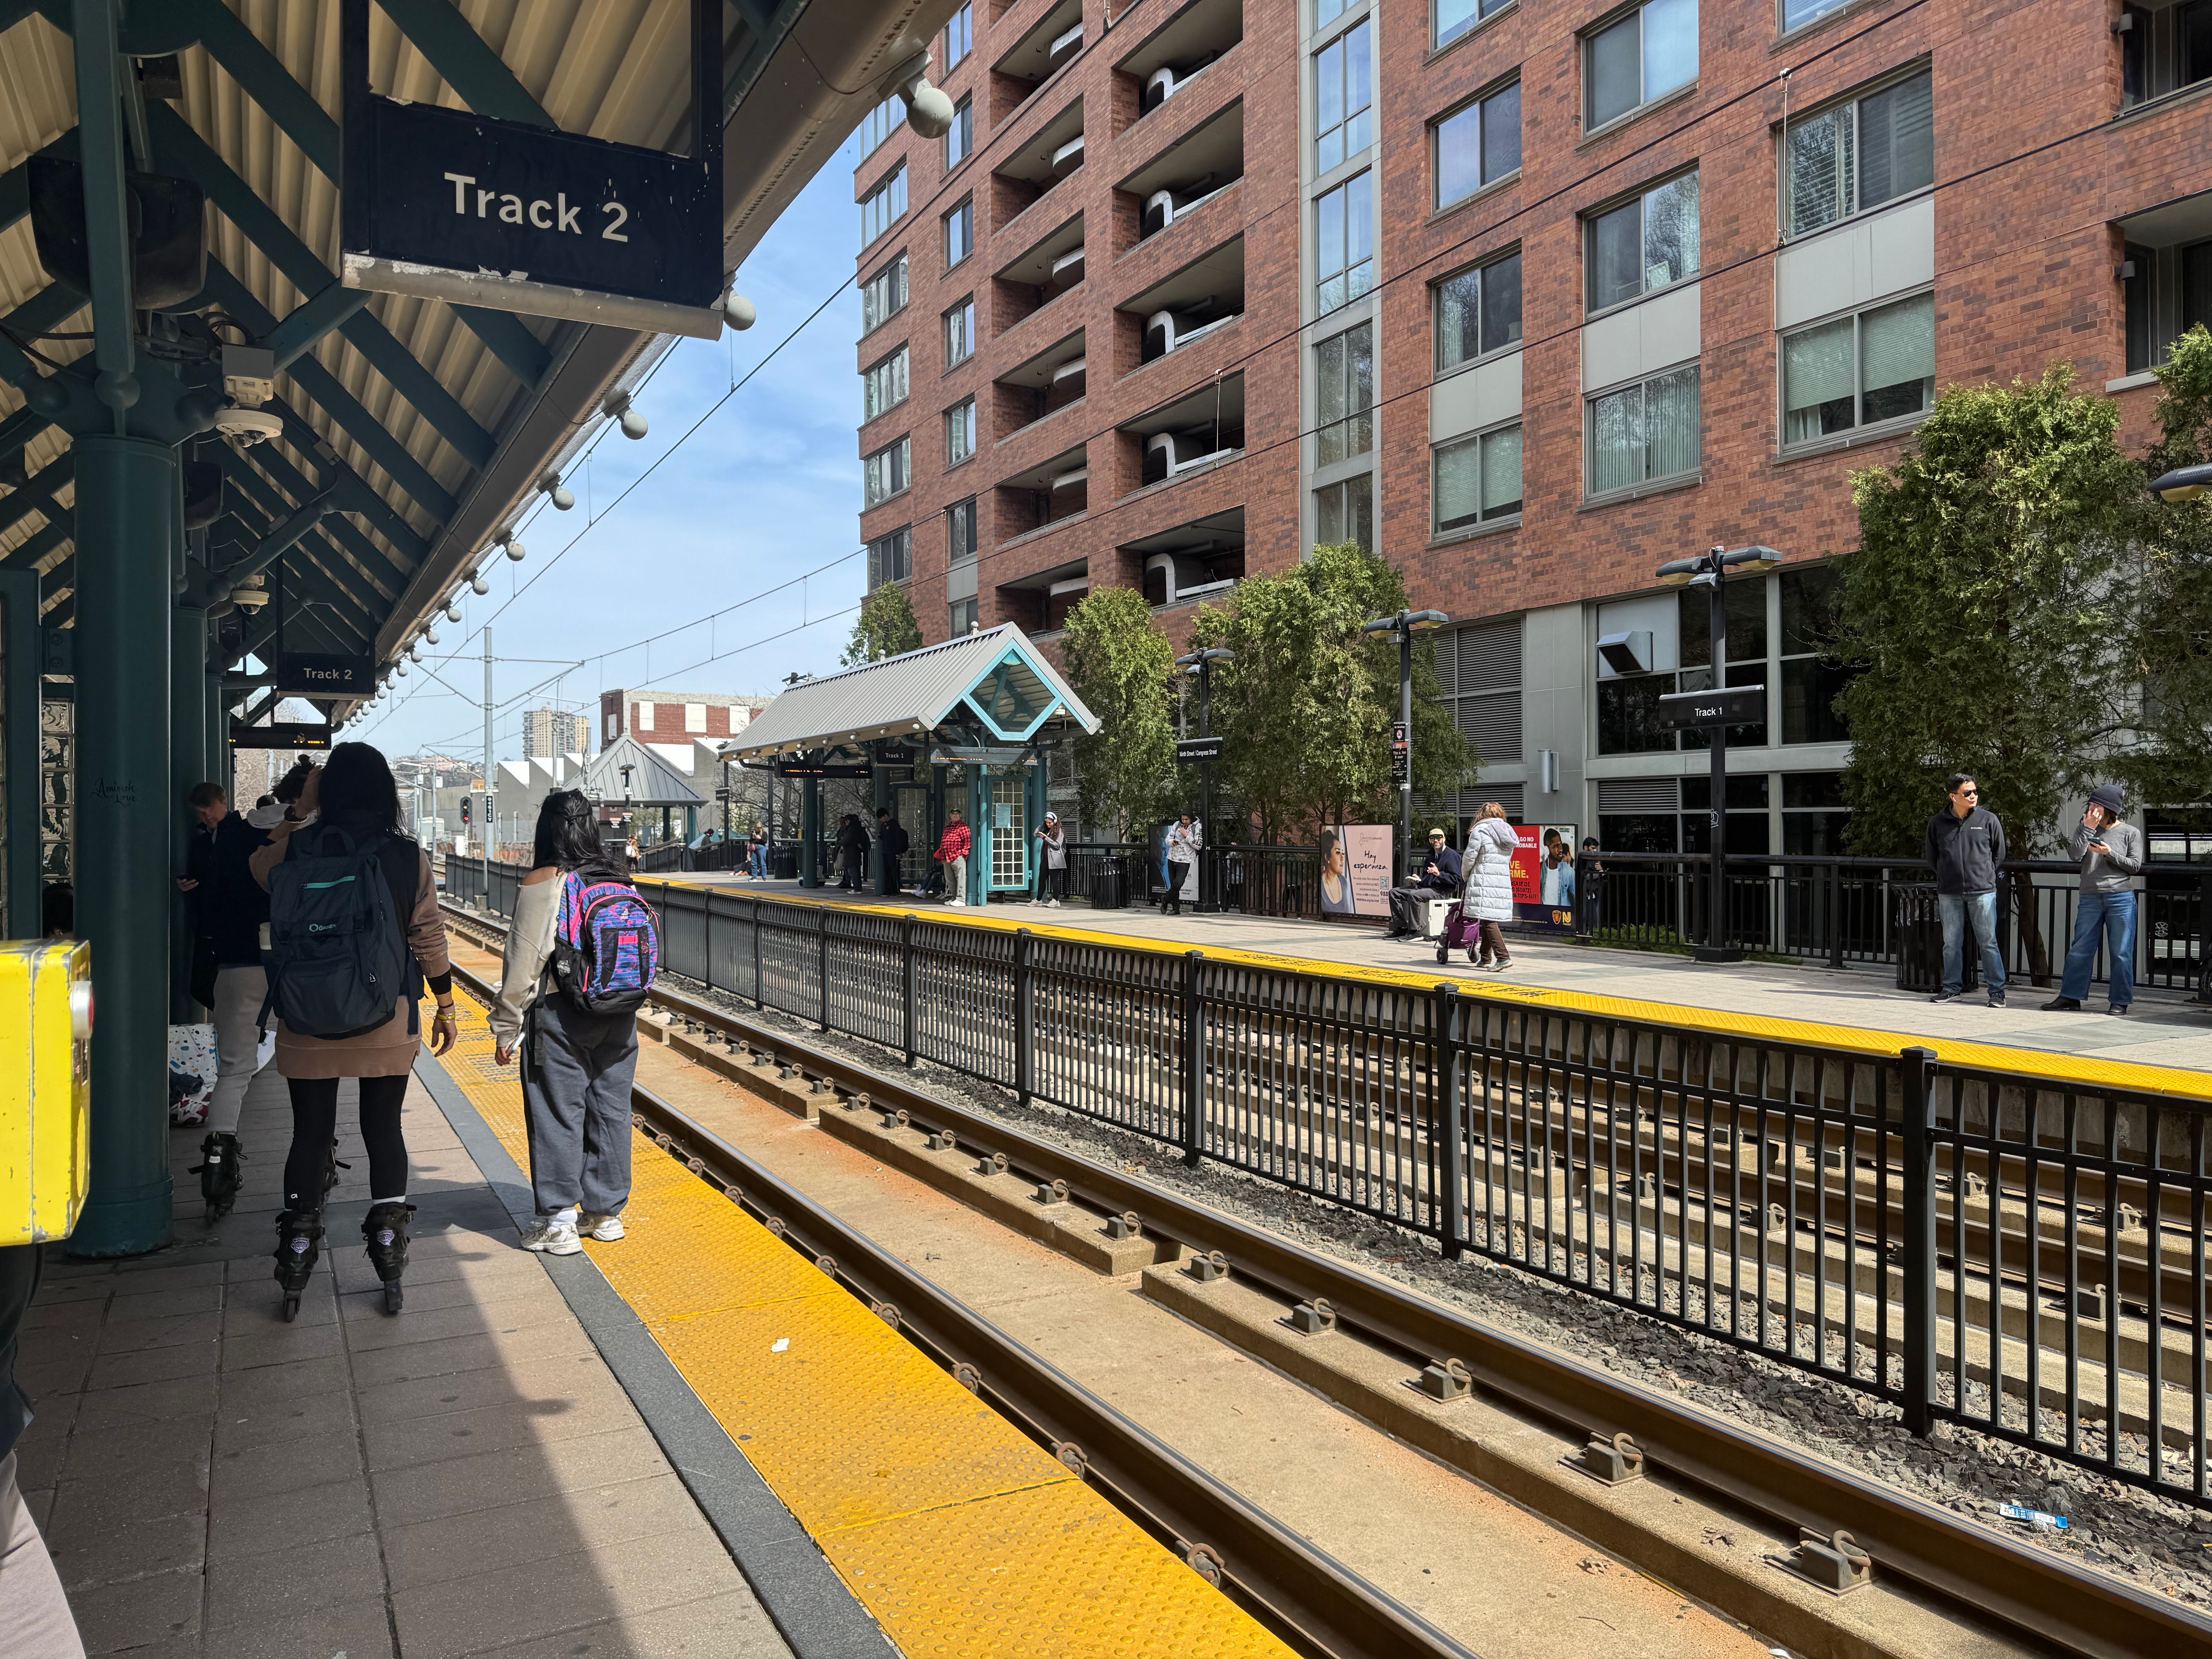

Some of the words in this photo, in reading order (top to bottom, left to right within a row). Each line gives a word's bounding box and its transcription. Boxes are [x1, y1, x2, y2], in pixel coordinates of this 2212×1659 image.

[444, 172, 582, 235] Track
[602, 202, 629, 242] 2
[303, 668, 340, 679] Track
[344, 669, 352, 680] 2
[1695, 707, 1716, 716] Track
[1719, 707, 1722, 715] 1
[1364, 850, 1376, 864] Hay
[1353, 863, 1388, 873] esperanza.
